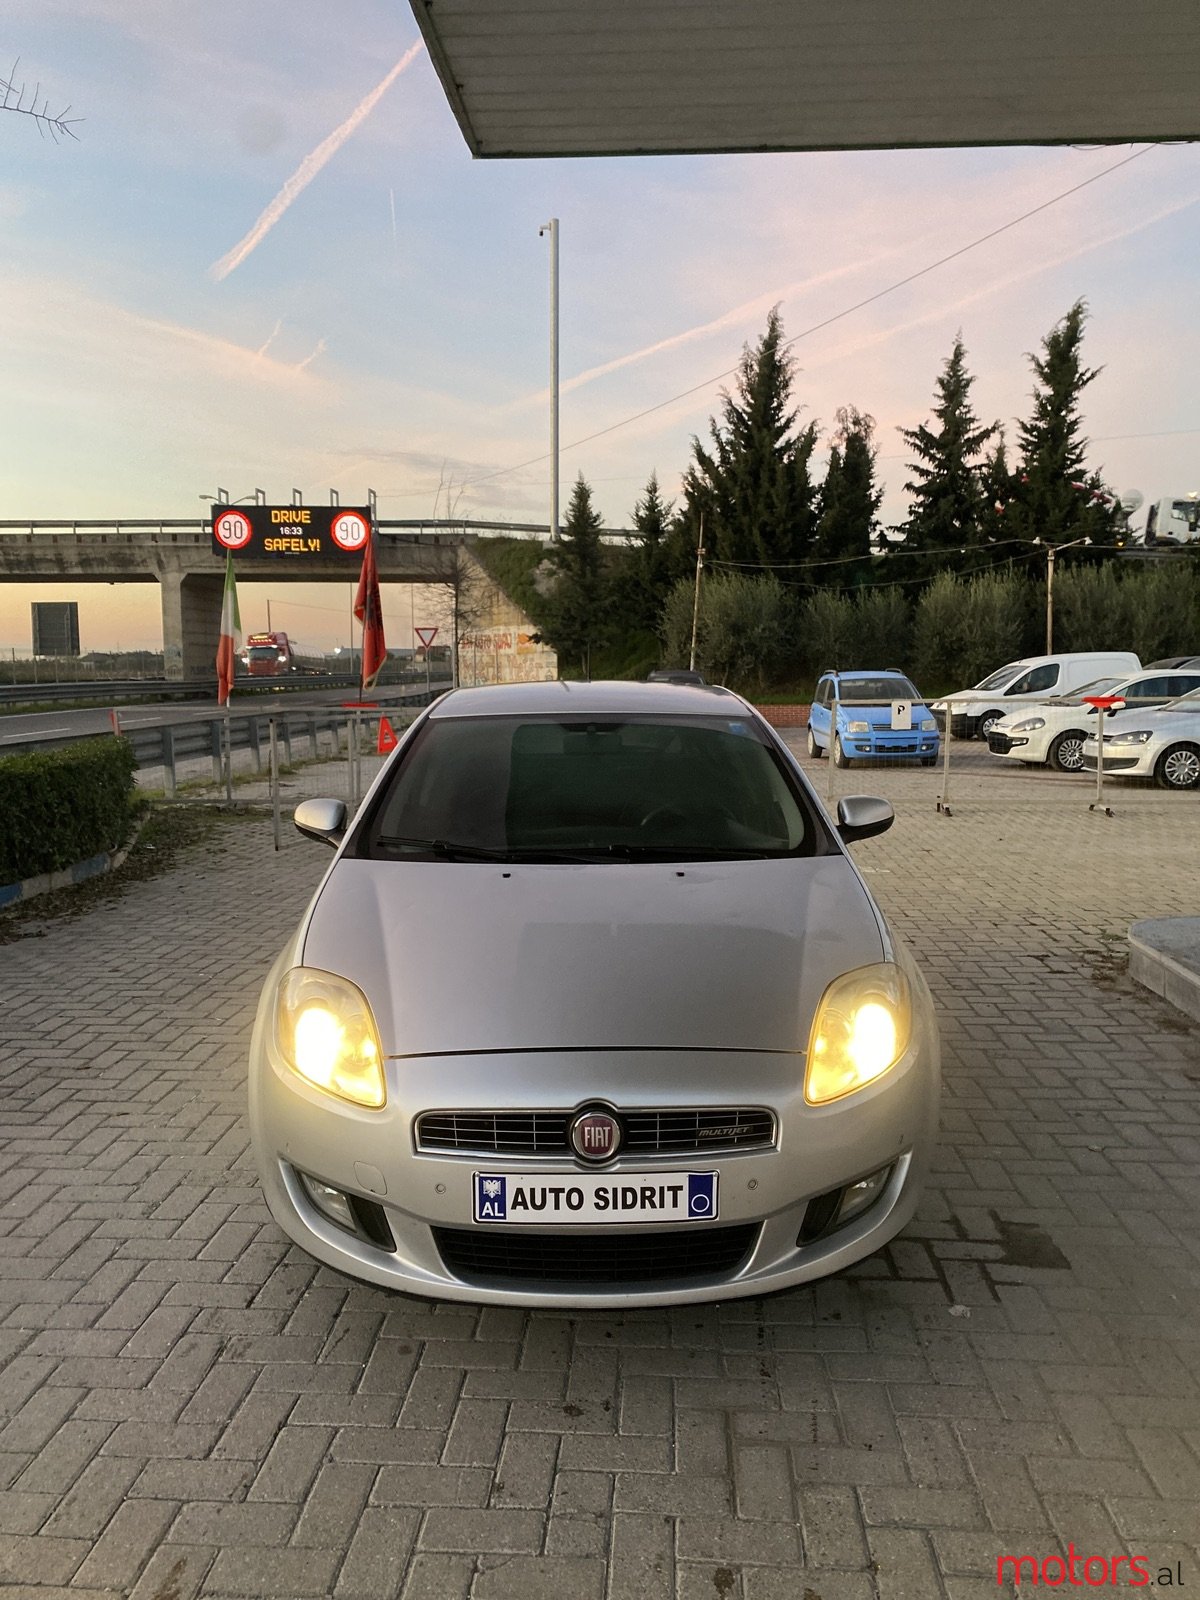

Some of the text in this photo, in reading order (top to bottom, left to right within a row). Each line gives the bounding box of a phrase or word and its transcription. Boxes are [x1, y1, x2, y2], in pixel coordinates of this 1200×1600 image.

[271, 510, 311, 524] DRIVE
[222, 520, 243, 540] 90
[279, 526, 303, 536] 16:33
[339, 522, 361, 541] 90
[264, 538, 320, 552] SAFELY!
[897, 705, 906, 715] P
[584, 1126, 611, 1149] FIAT
[511, 1185, 684, 1211] AUTO SIDRIT
[481, 1202, 504, 1217] AL
